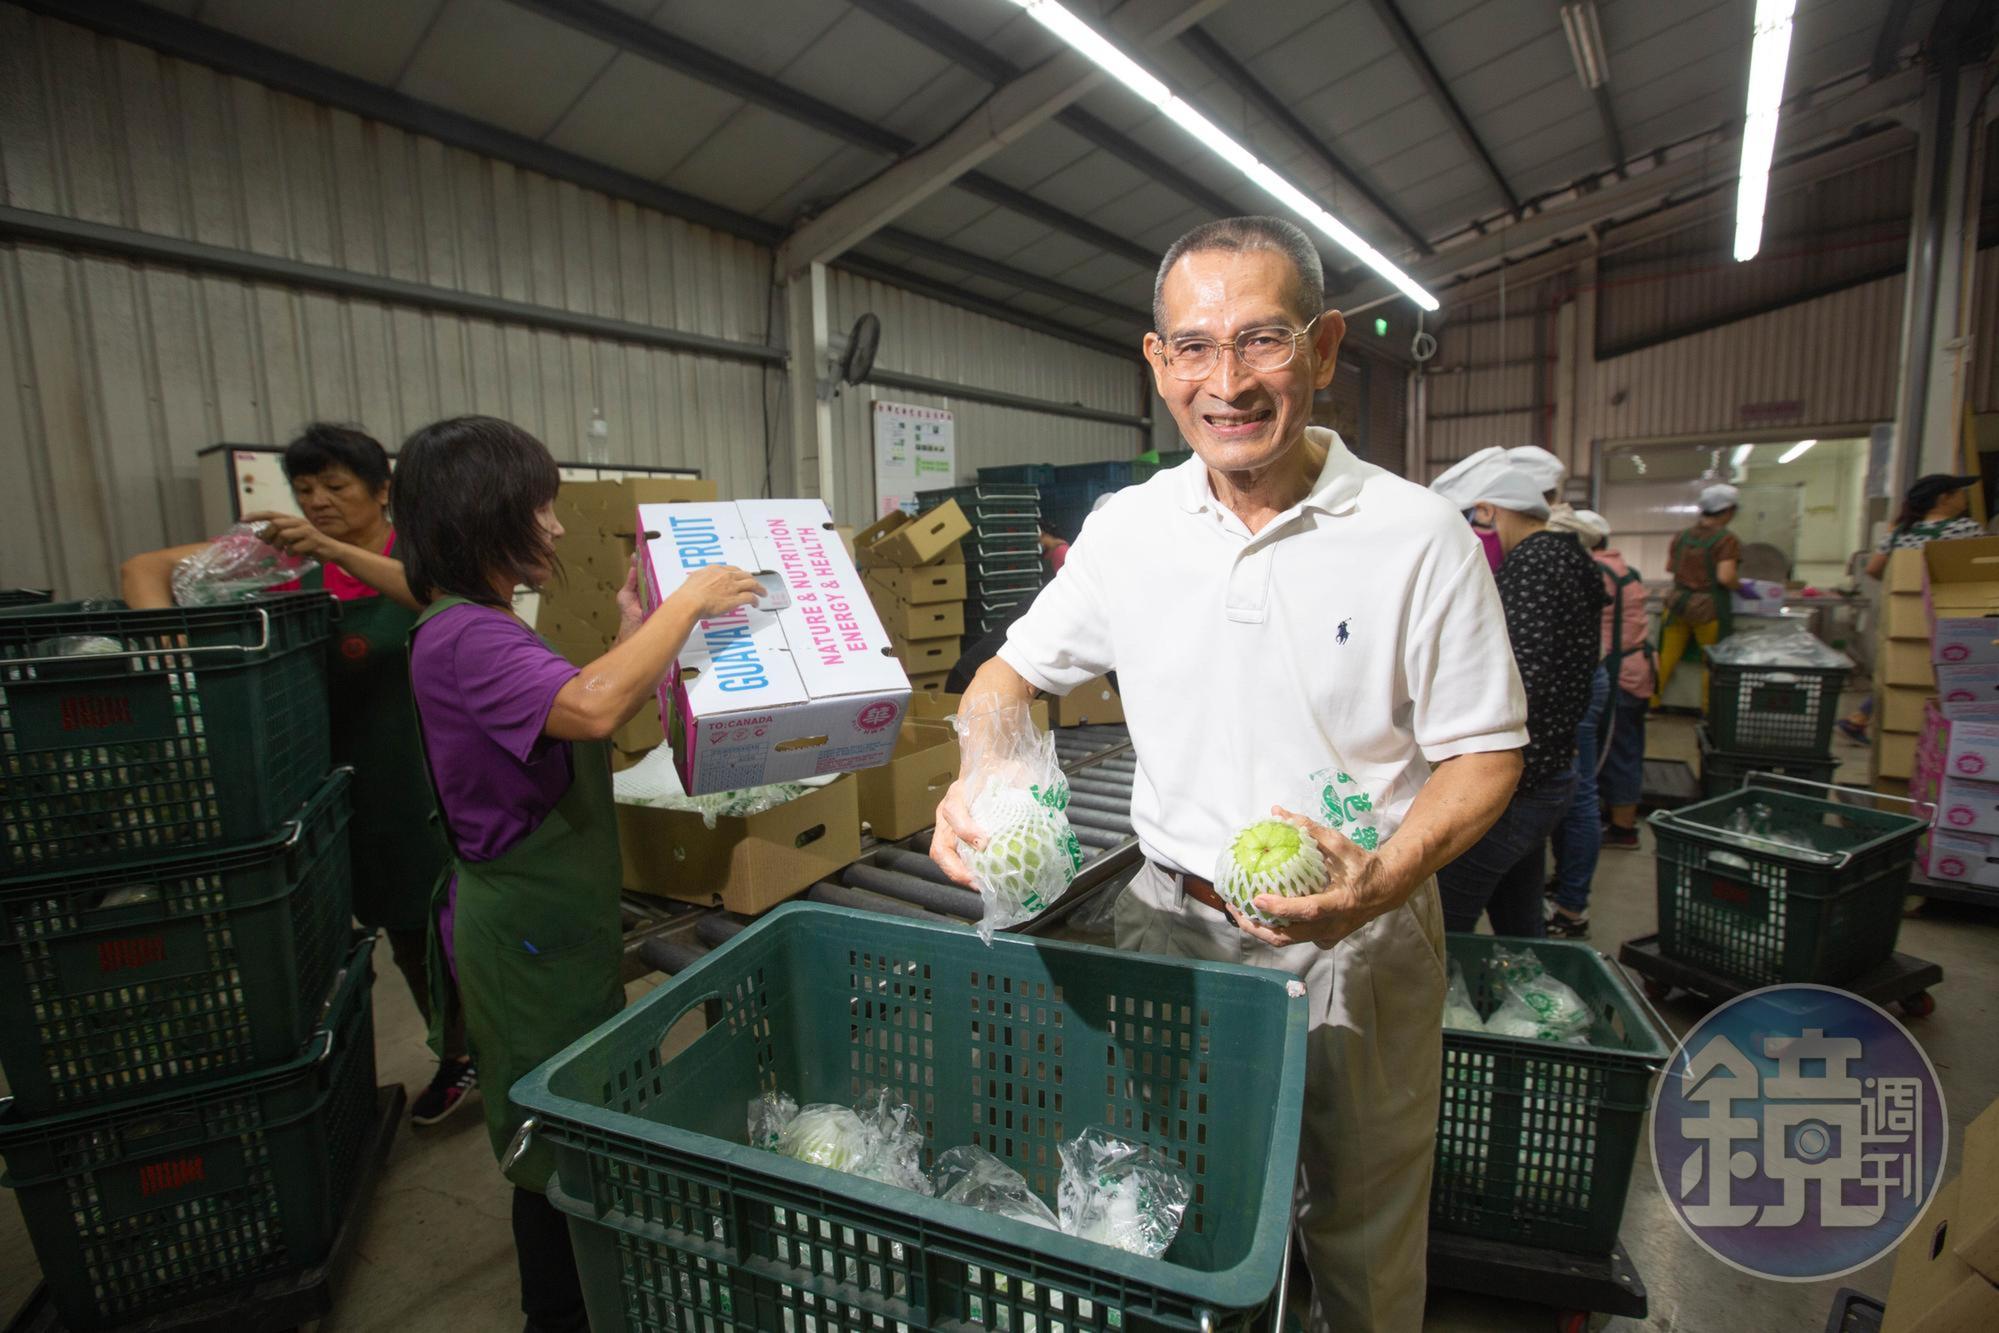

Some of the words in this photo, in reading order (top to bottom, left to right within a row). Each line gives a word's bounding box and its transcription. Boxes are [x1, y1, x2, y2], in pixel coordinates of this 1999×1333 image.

[668, 515, 727, 570] FRUIT
[768, 518, 812, 591] NUTRITION
[797, 527, 834, 578] HEALTH
[796, 592, 817, 604] &
[819, 579, 841, 590] &
[801, 605, 844, 666] NATURE
[826, 592, 868, 653] ENERGY
[703, 625, 769, 693] GUAVA
